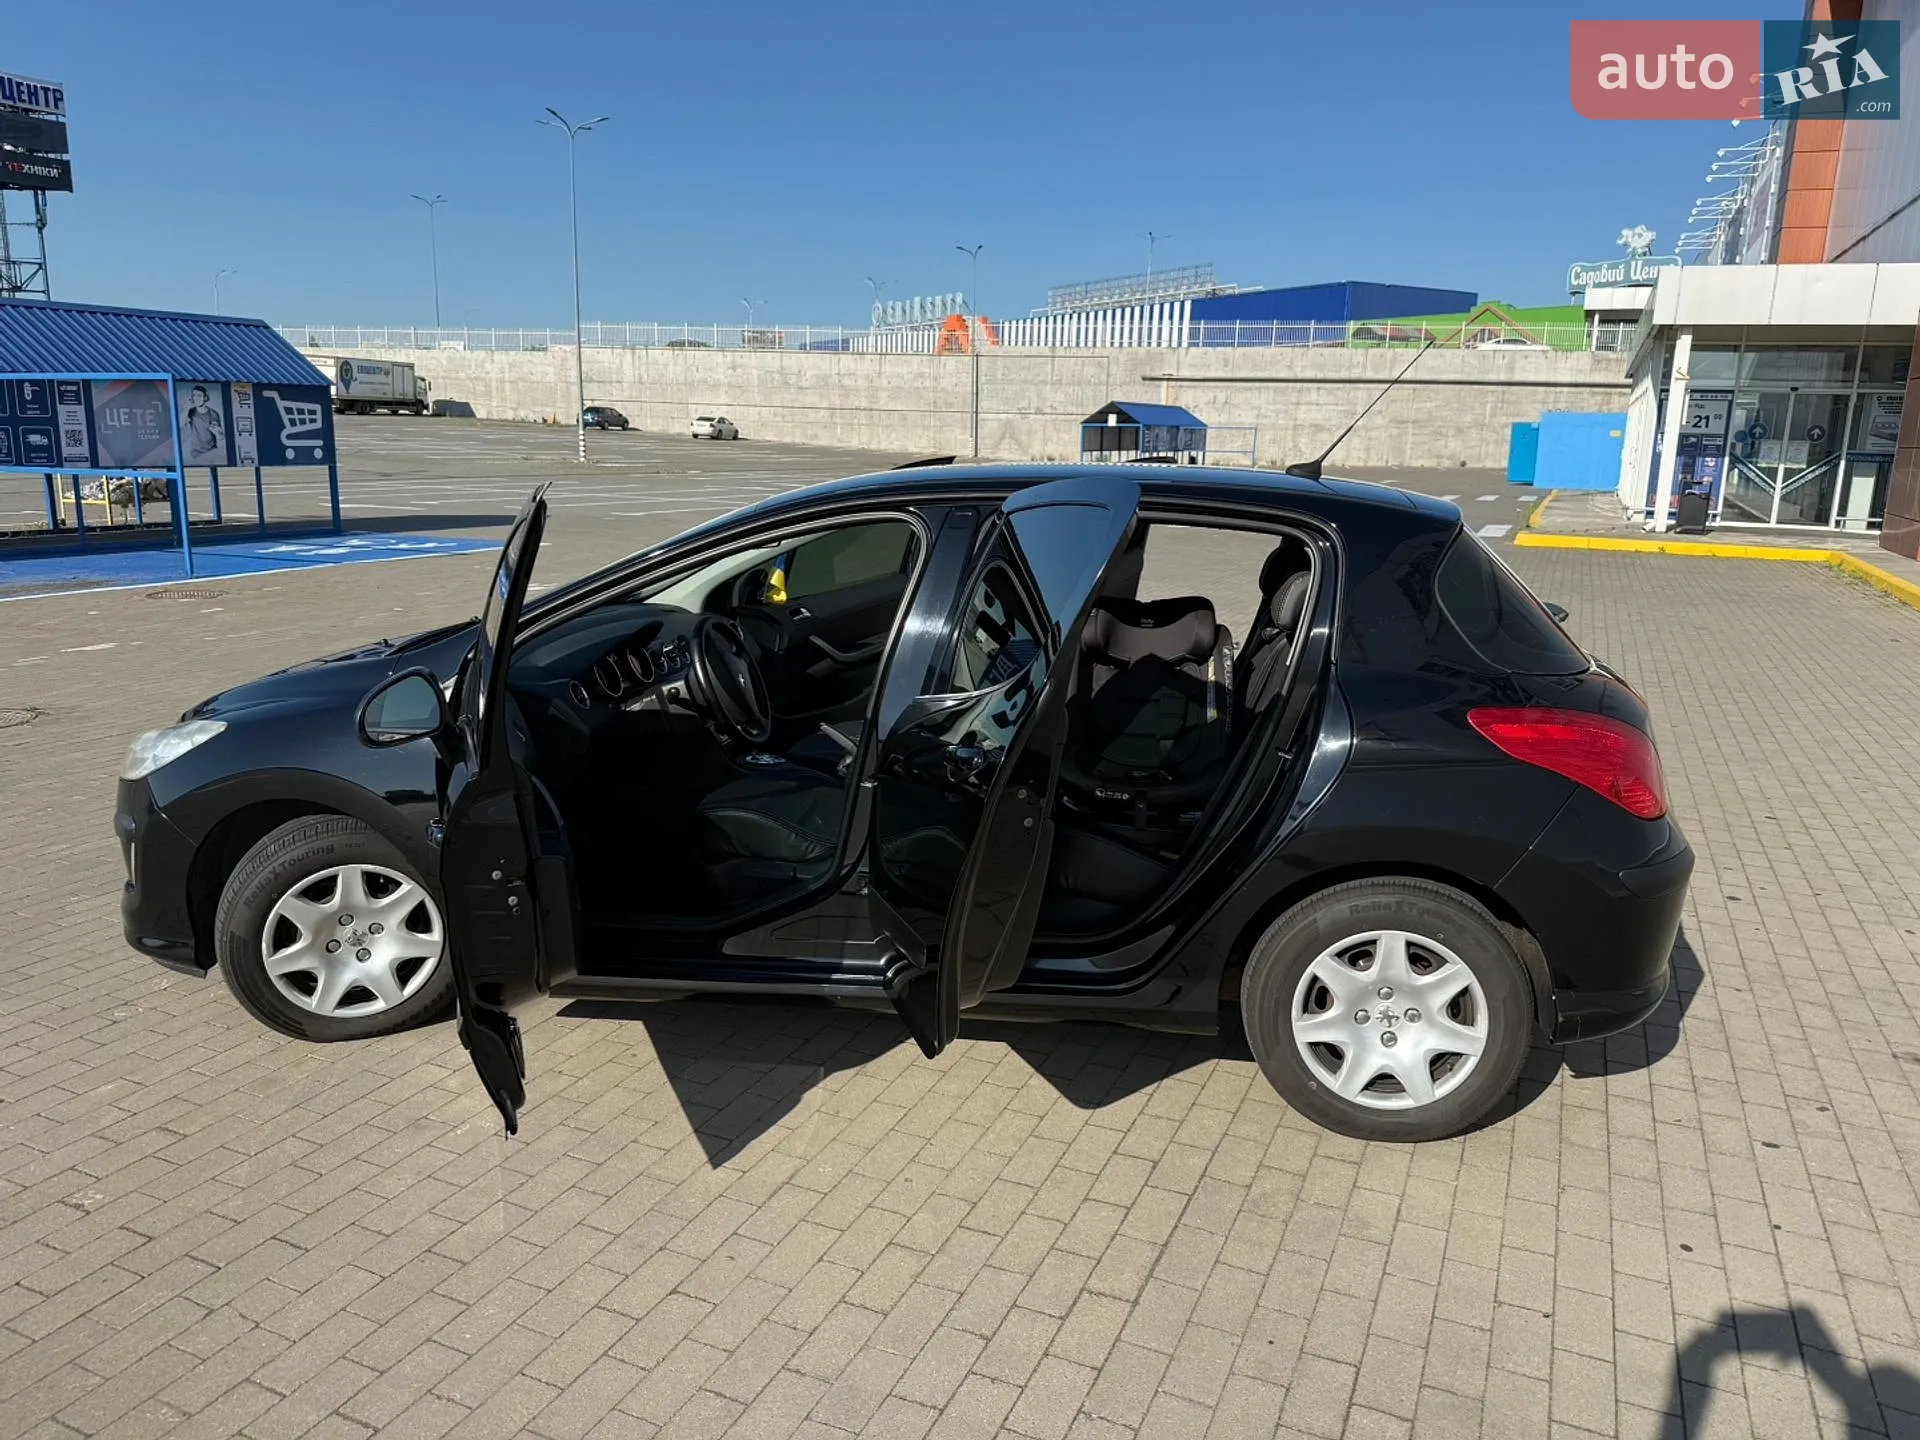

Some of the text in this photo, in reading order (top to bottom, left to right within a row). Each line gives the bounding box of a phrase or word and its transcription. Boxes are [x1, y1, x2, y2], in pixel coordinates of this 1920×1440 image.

[1571, 260, 1660, 288] Садовий Цен
[1692, 414, 1710, 428] 21
